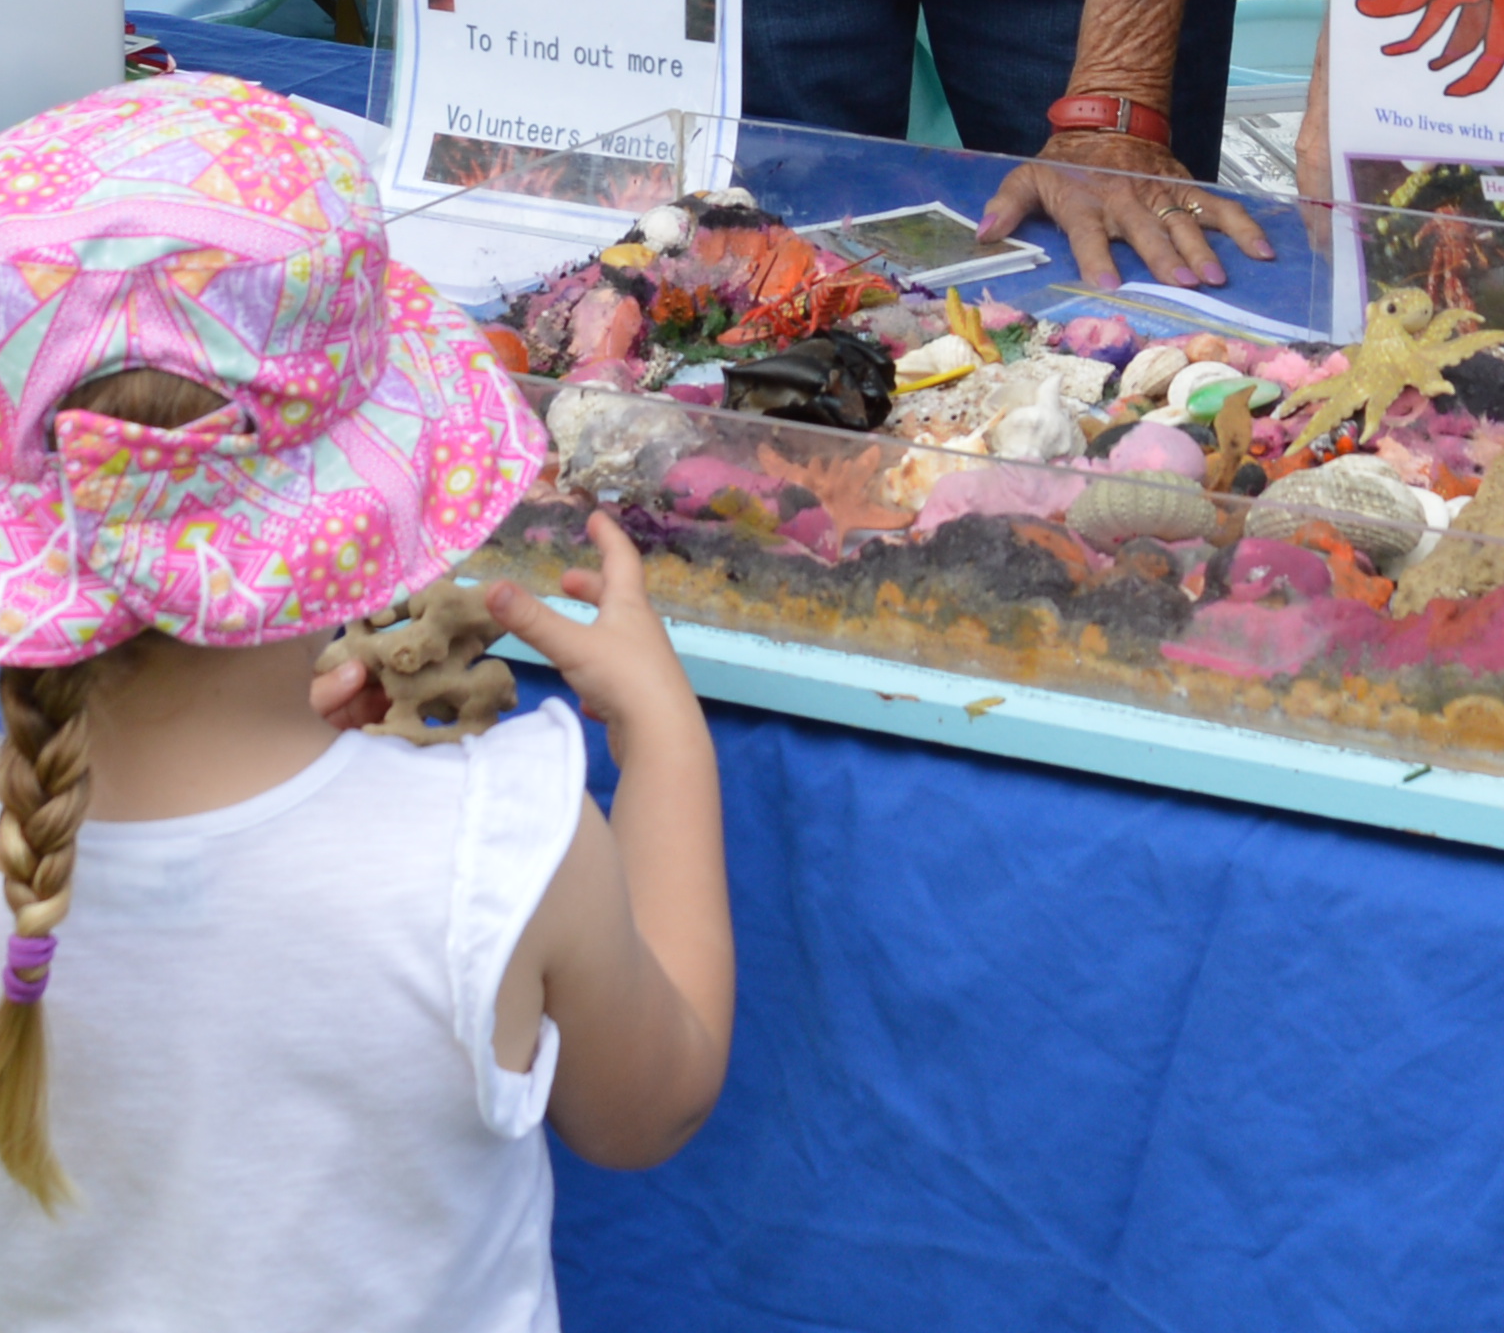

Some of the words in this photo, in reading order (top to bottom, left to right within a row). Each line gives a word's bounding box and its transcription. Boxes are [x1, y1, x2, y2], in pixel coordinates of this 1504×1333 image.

[466, 24, 492, 53] To
[506, 30, 560, 62] find
[574, 44, 614, 69] out
[627, 52, 684, 78] more
[446, 104, 581, 148] Volunteers
[1375, 107, 1413, 129] Who
[1418, 114, 1454, 135] lives
[1459, 122, 1494, 142] with
